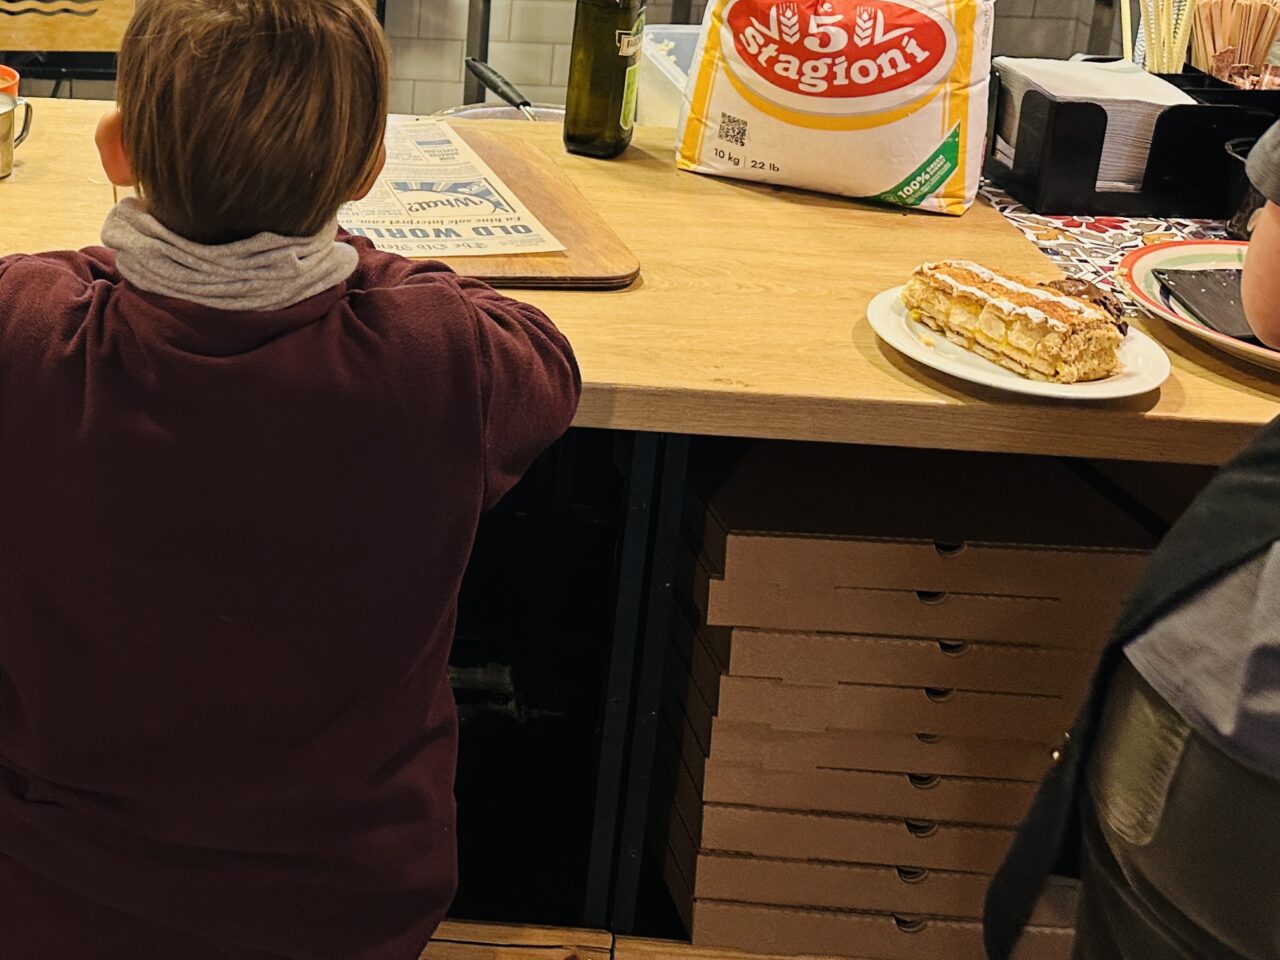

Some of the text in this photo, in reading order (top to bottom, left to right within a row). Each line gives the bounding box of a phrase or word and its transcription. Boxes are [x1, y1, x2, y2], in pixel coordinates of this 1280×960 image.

[803, 13, 849, 53] 5
[739, 25, 931, 94] Stagioni
[714, 147, 780, 172] 10 kg 22 lb
[897, 171, 930, 198] 100%
[347, 224, 533, 238] OLD WORLD
